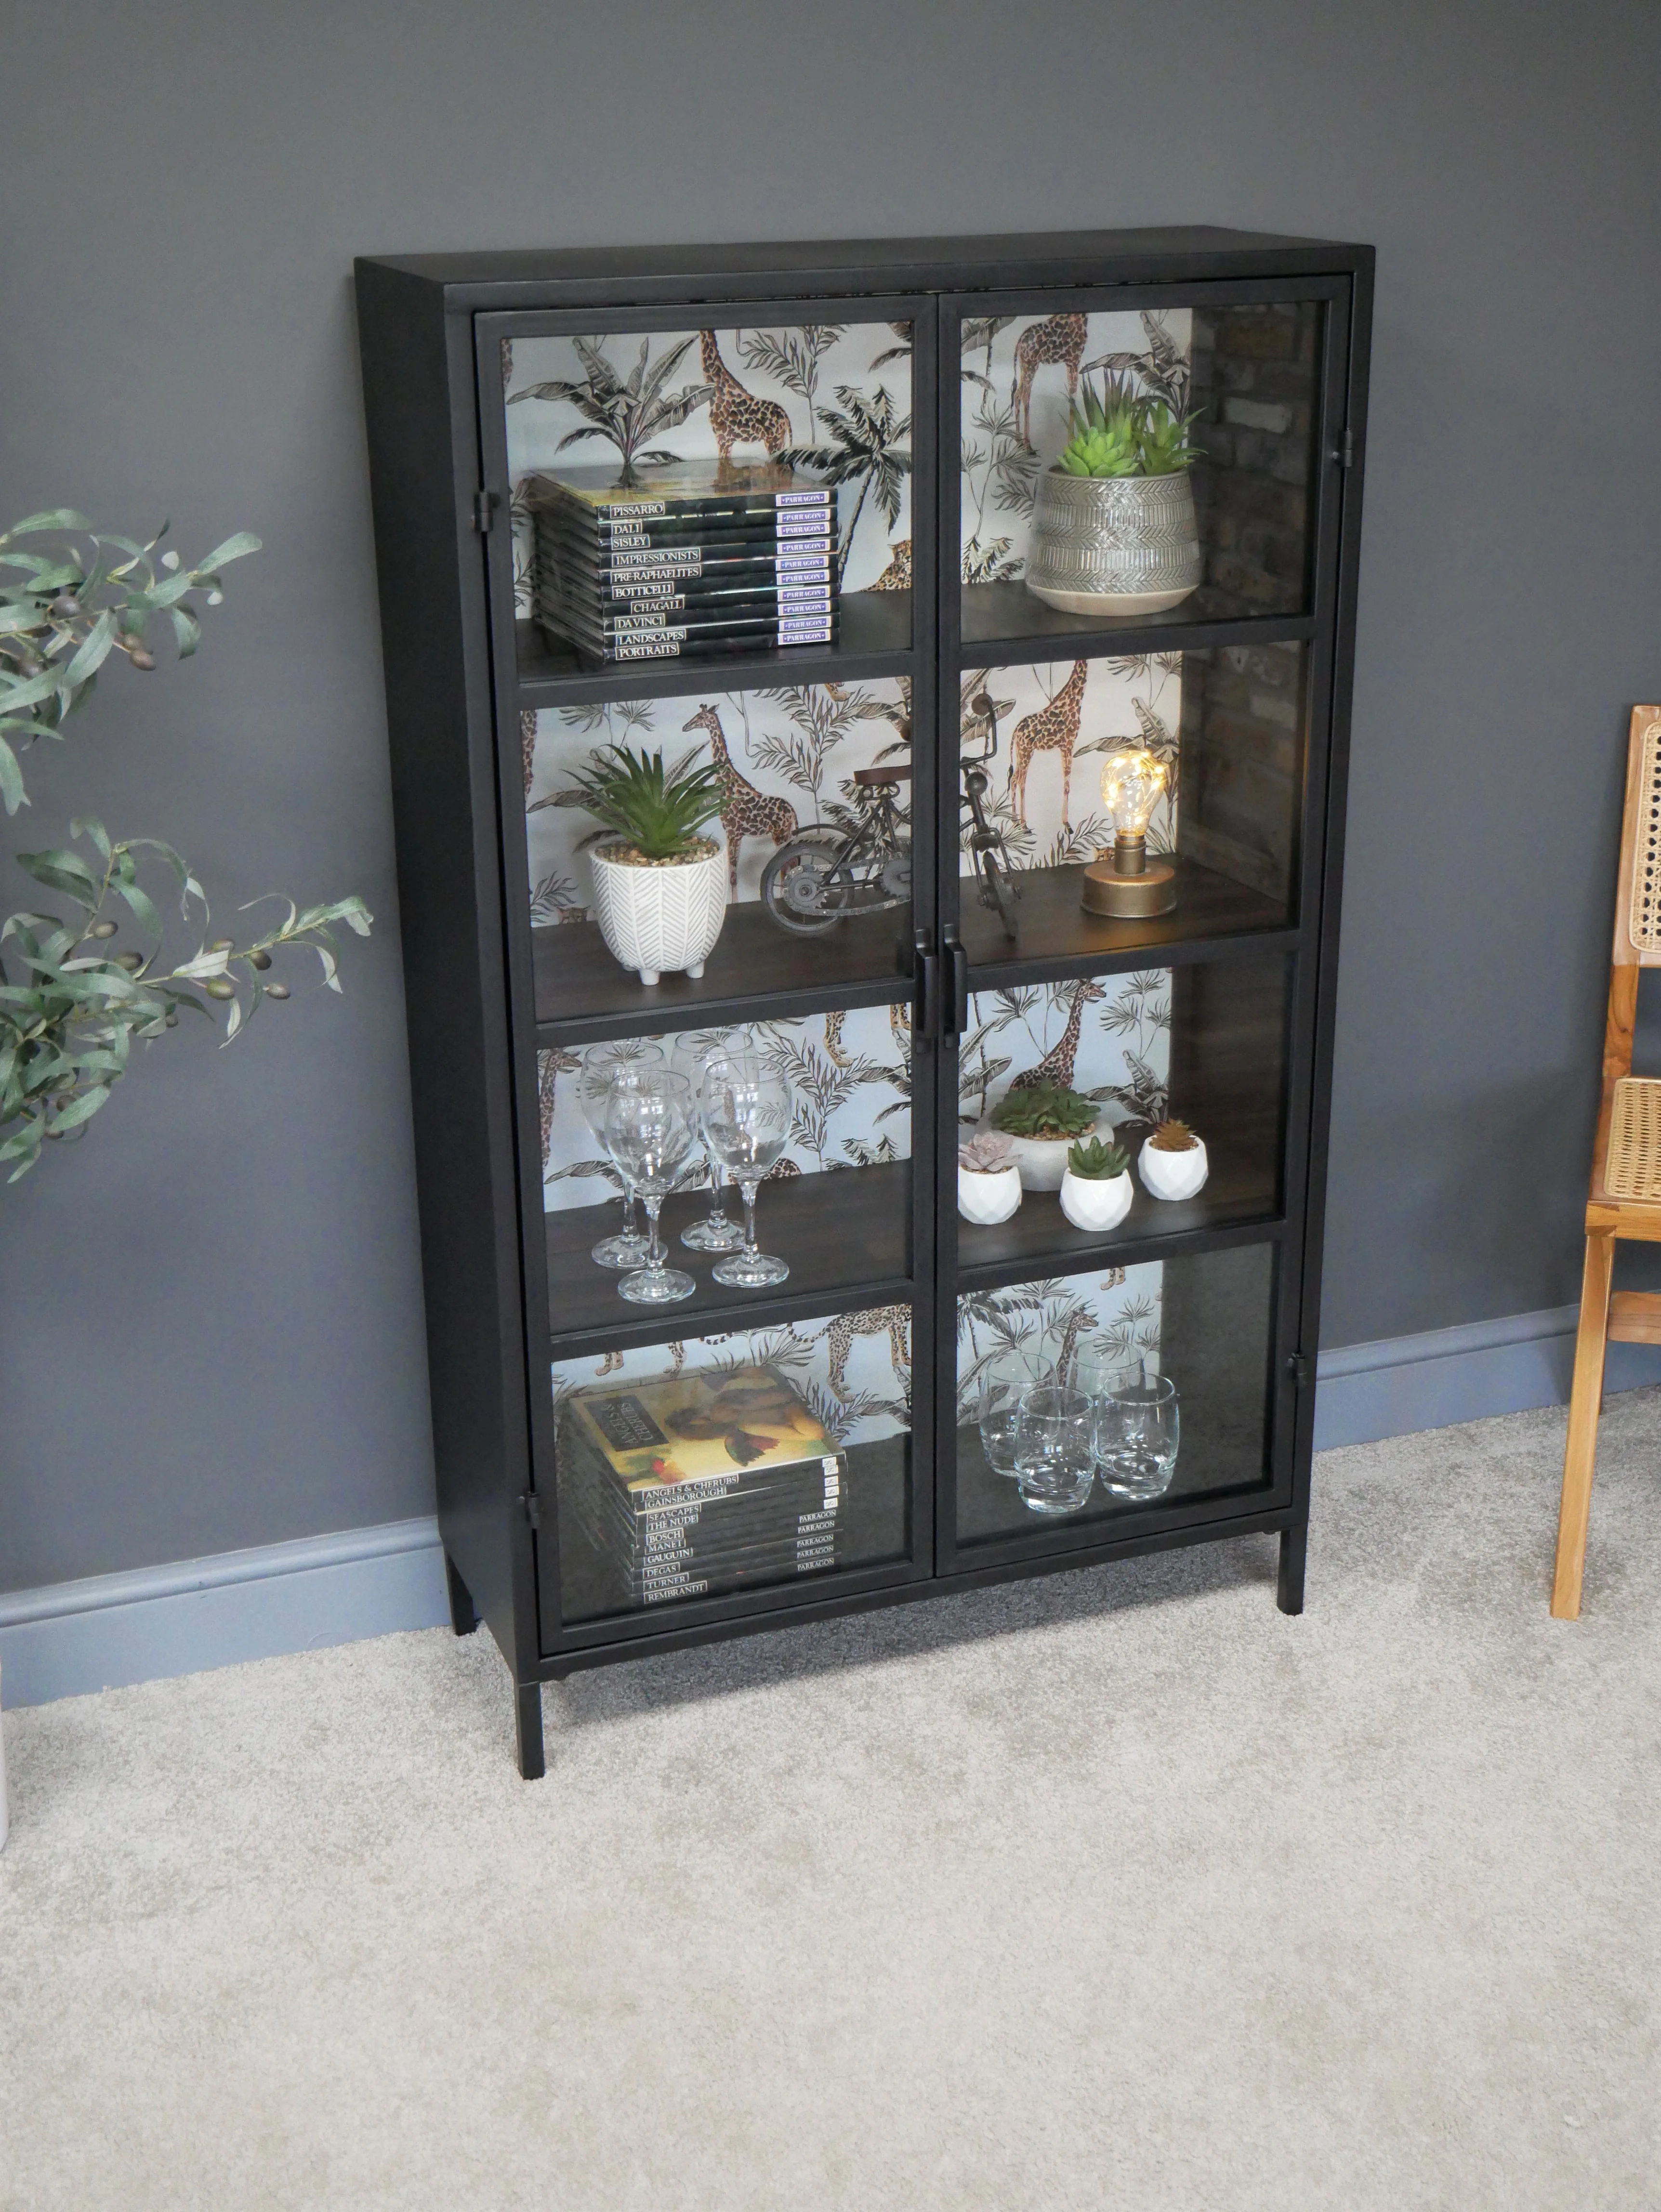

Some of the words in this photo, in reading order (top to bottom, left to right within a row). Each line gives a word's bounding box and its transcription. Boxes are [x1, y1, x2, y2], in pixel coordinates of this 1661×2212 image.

[612, 504, 663, 516] PISSARRO
[614, 524, 640, 535] DALI
[613, 537, 646, 548] SISLEY
[615, 551, 698, 566] IMPRESSIONISTS
[613, 567, 699, 582] PRE-RAPHAELITES
[614, 584, 671, 598] BOTTICELLI
[633, 600, 682, 613] CHAGALL
[618, 619, 633, 628] DA
[633, 617, 662, 627] VINCI
[619, 631, 684, 645] LANDSCAPES
[619, 645, 677, 658] PORTRAITS
[646, 1487, 682, 1499] ANGELS
[694, 1476, 737, 1490] CHERUBS
[648, 1487, 724, 1508] GAINSBOROUGH
[649, 1505, 699, 1522] SEASCAPES
[799, 1509, 836, 1523] PARRAGON
[649, 1521, 668, 1531] THE
[670, 1514, 696, 1527] NUDE
[798, 1520, 835, 1534] PARRAGON
[648, 1530, 681, 1544] BOSCH
[797, 1534, 834, 1548] PARRAGON
[649, 1539, 682, 1553] MANET
[797, 1545, 834, 1558] PARRAGON
[647, 1548, 690, 1564] GAUGUIN
[646, 1565, 677, 1578] DEGAS
[797, 1558, 834, 1572] PARRAGON
[647, 1576, 685, 1590] TURNER
[647, 1583, 705, 1601] REMBRANDT
